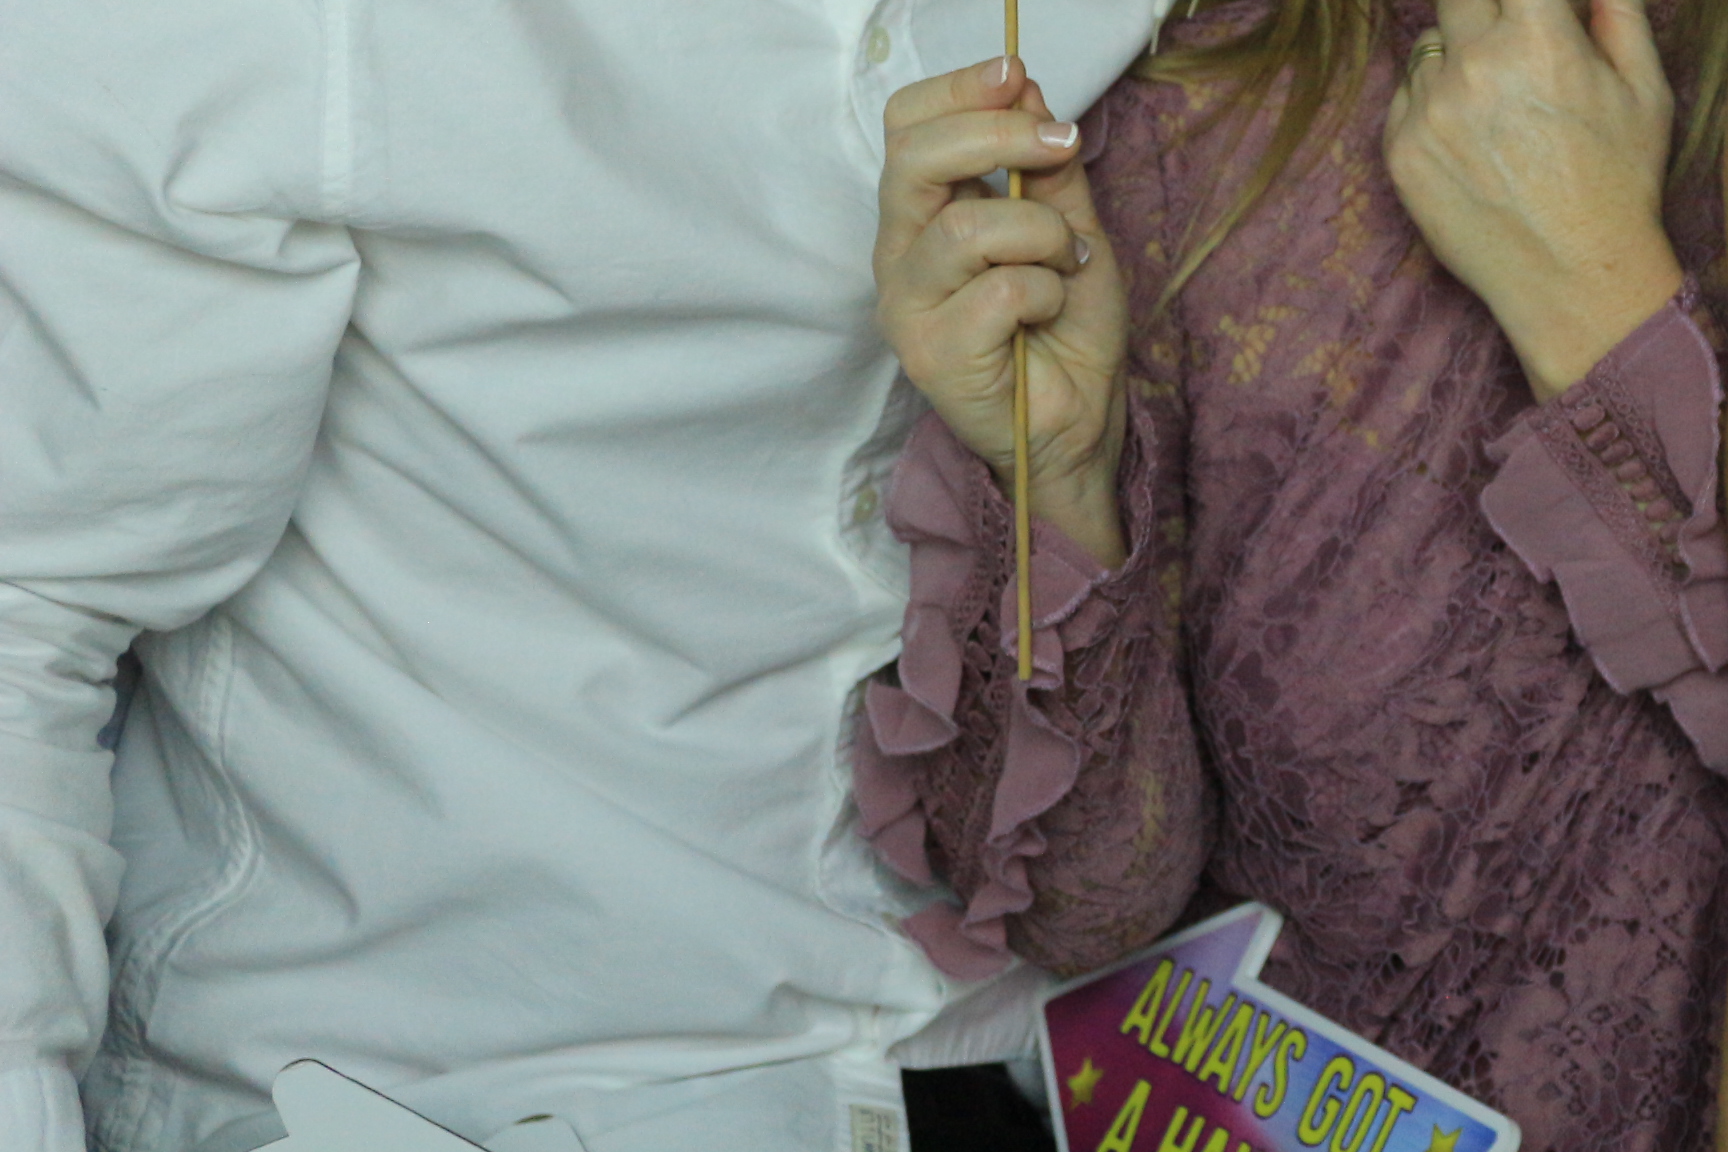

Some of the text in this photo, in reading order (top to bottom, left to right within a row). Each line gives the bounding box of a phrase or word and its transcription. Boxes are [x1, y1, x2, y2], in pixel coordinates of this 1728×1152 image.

[1095, 1077, 1153, 1152] A
[1119, 957, 1419, 1152] ALWAYS GOT
